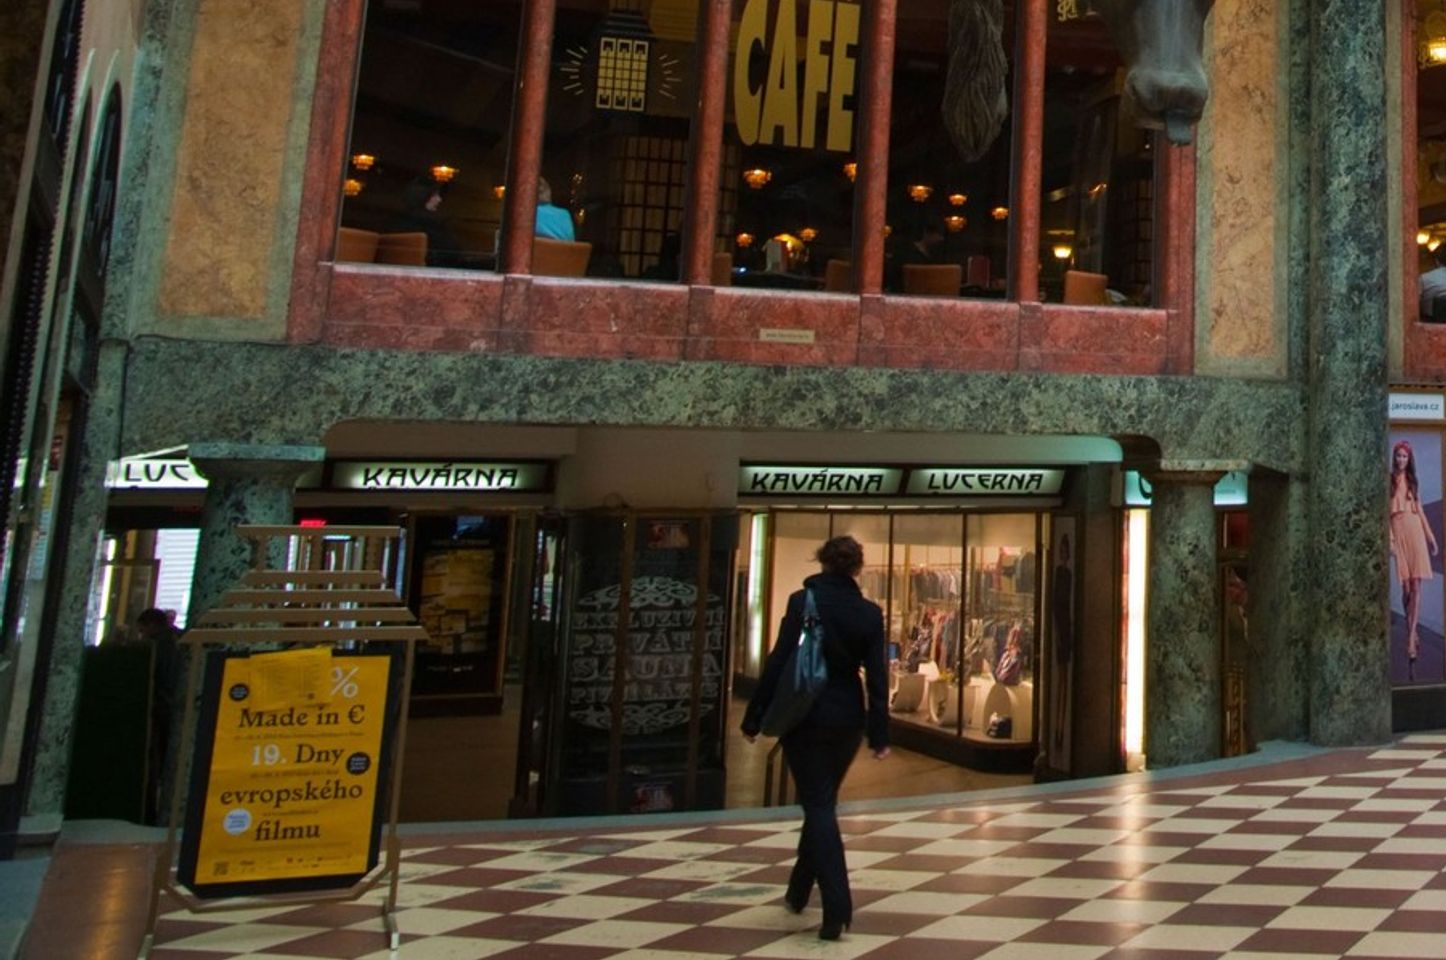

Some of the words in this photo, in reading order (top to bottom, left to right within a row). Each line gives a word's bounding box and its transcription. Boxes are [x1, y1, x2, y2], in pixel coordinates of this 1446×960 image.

[362, 462, 518, 486] KAVÁRNA
[750, 467, 884, 491] KAVÁRNA
[927, 472, 1043, 490] LUCERNA
[238, 707, 309, 728] Made
[316, 704, 339, 725] in
[348, 704, 365, 724] €
[251, 743, 288, 767] 19.
[294, 743, 346, 766] Dny
[220, 778, 364, 808] evropského
[254, 818, 321, 842] filmu
